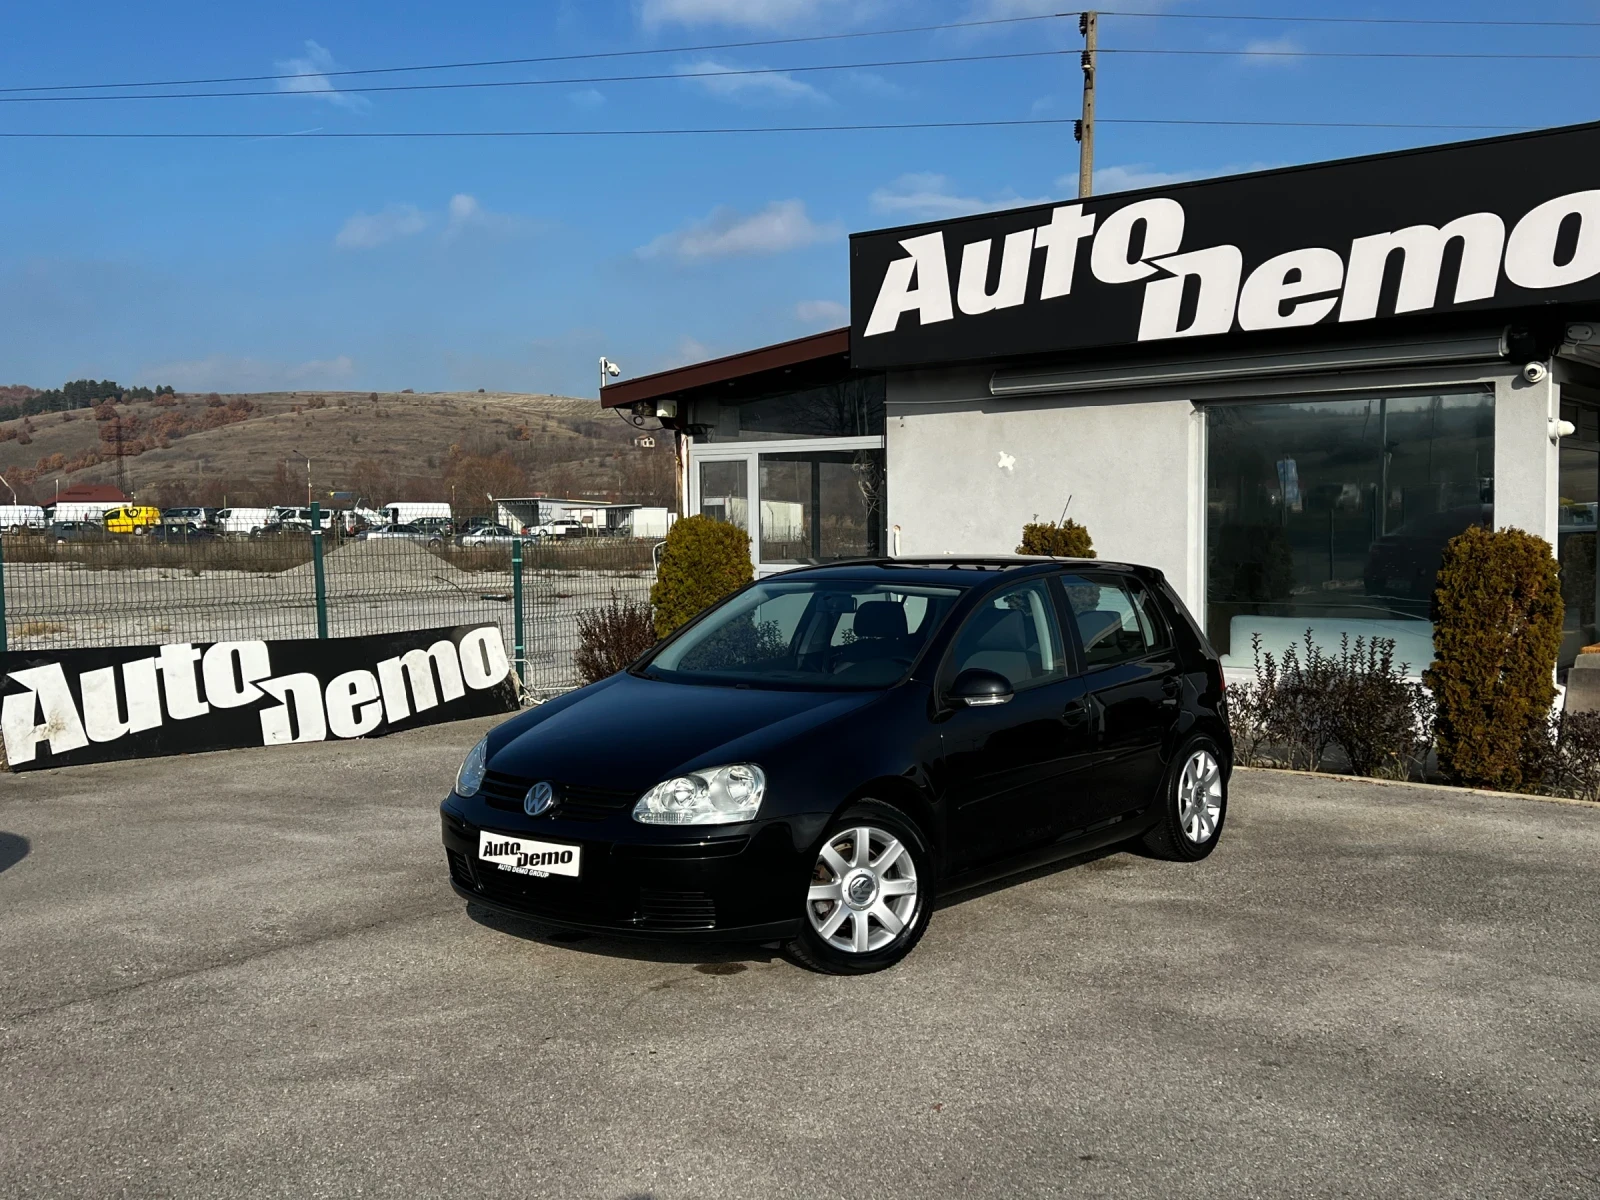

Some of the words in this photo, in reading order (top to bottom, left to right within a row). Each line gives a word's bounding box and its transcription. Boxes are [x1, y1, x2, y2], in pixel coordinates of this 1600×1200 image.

[863, 197, 1186, 337] Auto
[1137, 189, 1600, 341] Demo
[2, 640, 272, 766] Auto
[253, 626, 511, 746] Demo
[524, 781, 553, 816] VW
[483, 841, 521, 857] Auto
[516, 850, 573, 867] Demo
[497, 863, 512, 872] AUTO
[511, 866, 529, 875] DEMO
[528, 869, 550, 878] GROUP
